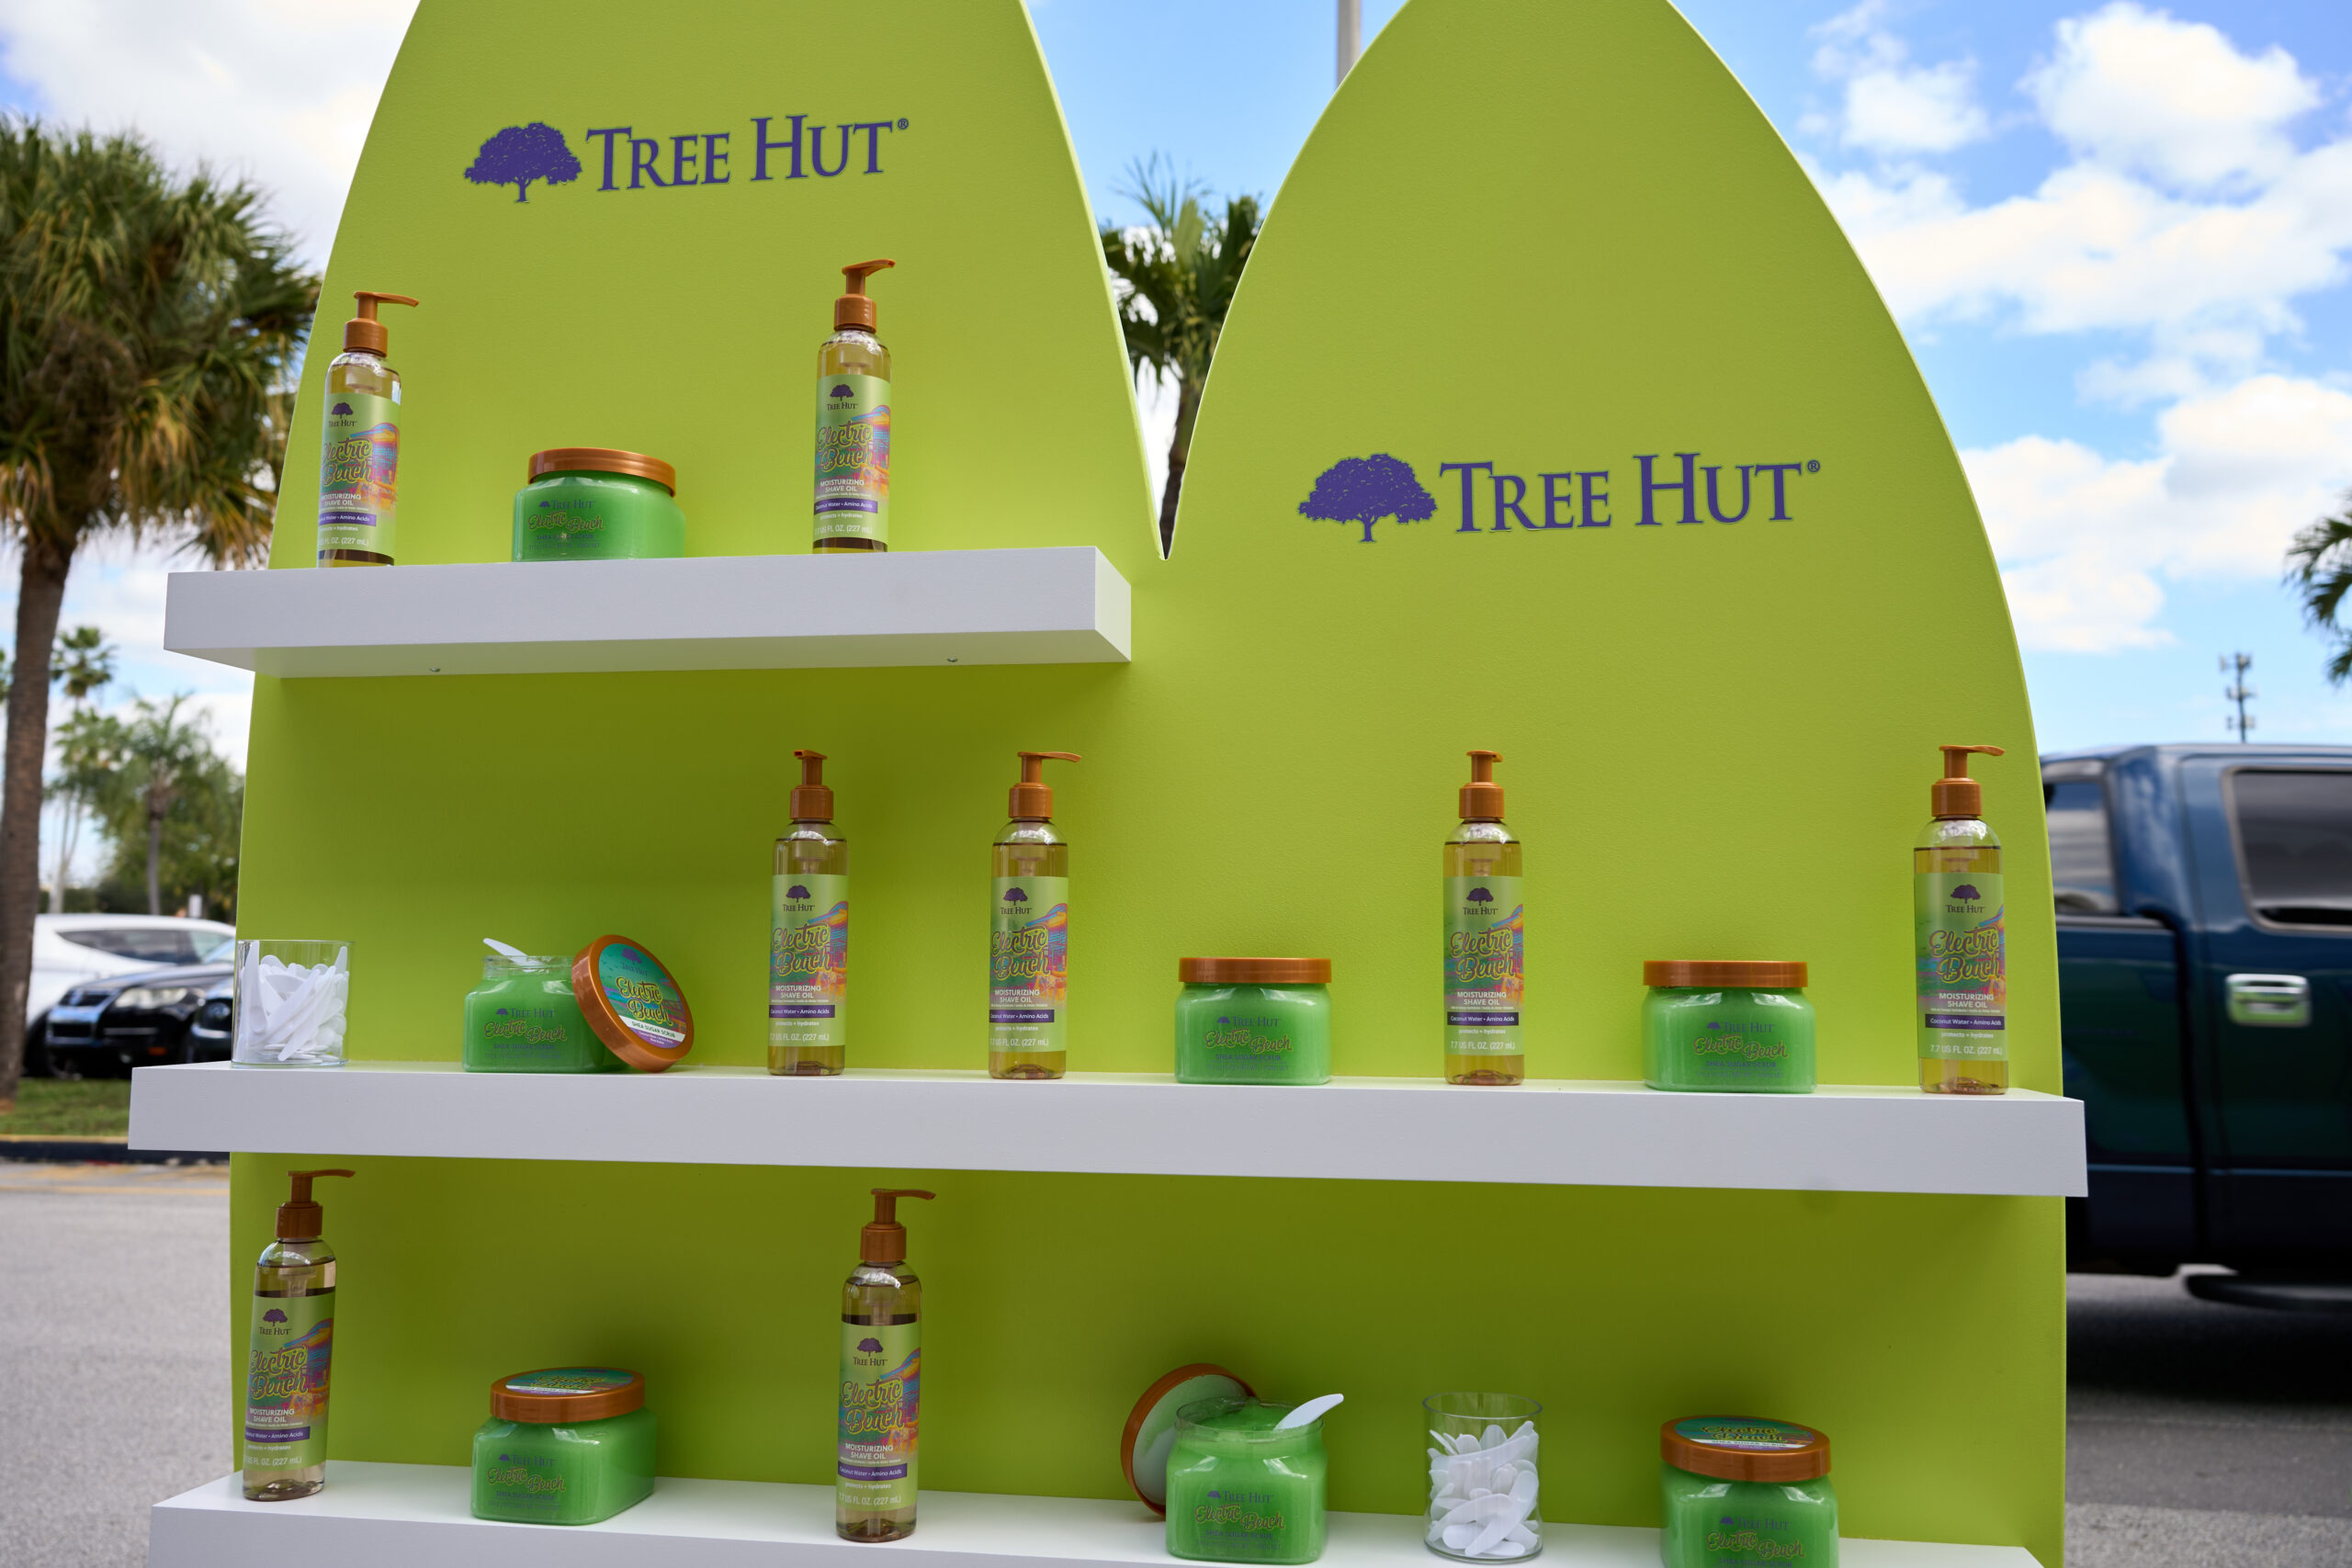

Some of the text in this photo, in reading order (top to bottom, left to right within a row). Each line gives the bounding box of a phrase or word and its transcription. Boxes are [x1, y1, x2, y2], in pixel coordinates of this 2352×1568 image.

[585, 126, 731, 192] TREE
[817, 420, 872, 448] Electric
[821, 444, 875, 471] Beach
[323, 462, 373, 486] Beach
[1440, 461, 1611, 534] TREE
[1000, 907, 1030, 915] TREE HUT
[1946, 905, 1984, 914] TREE HUT
[773, 923, 830, 953] Electric
[991, 925, 1049, 956] Electric
[1451, 926, 1512, 958] Electric
[1929, 926, 1999, 958] Electric
[775, 947, 831, 976] Beach
[994, 951, 1051, 981] Beach
[1456, 953, 1515, 982] Beach
[1937, 953, 2001, 984] Beach
[616, 976, 663, 1005] Electric
[628, 998, 673, 1027] Beach
[250, 1345, 307, 1375] Electric
[854, 1357, 886, 1366] TREE HUT
[250, 1372, 308, 1400] Beach
[842, 1377, 903, 1408] Electric
[845, 1403, 905, 1434] Beach
[845, 1443, 894, 1451] MOISTURIZING
